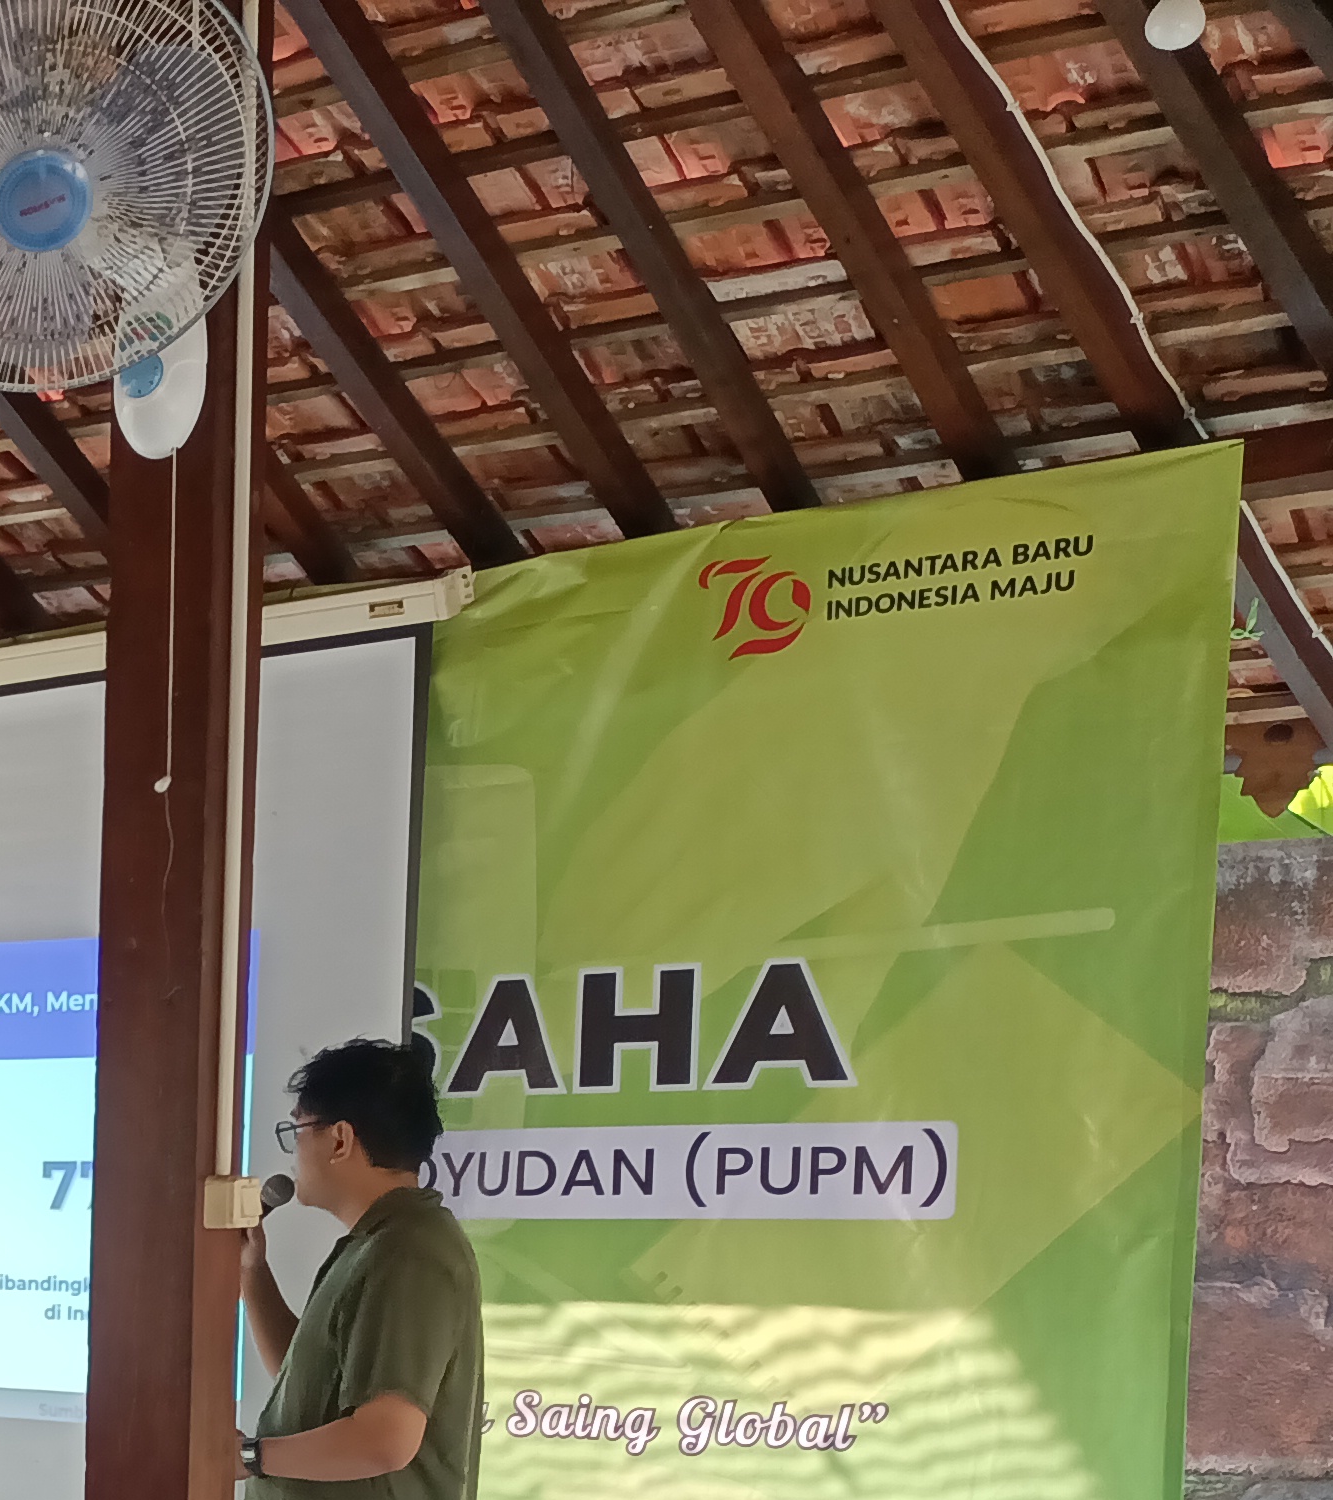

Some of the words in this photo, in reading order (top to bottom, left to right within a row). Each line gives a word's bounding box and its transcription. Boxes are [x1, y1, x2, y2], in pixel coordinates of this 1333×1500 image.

[827, 547, 1002, 589] NUSANTARA
[1011, 534, 1094, 566] BARU
[826, 582, 980, 621] INDONESIA
[989, 569, 1075, 600] MAJU
[685, 1128, 949, 1208] (PUPM)
[44, 1303, 62, 1321] di
[505, 1389, 661, 1456] Saing
